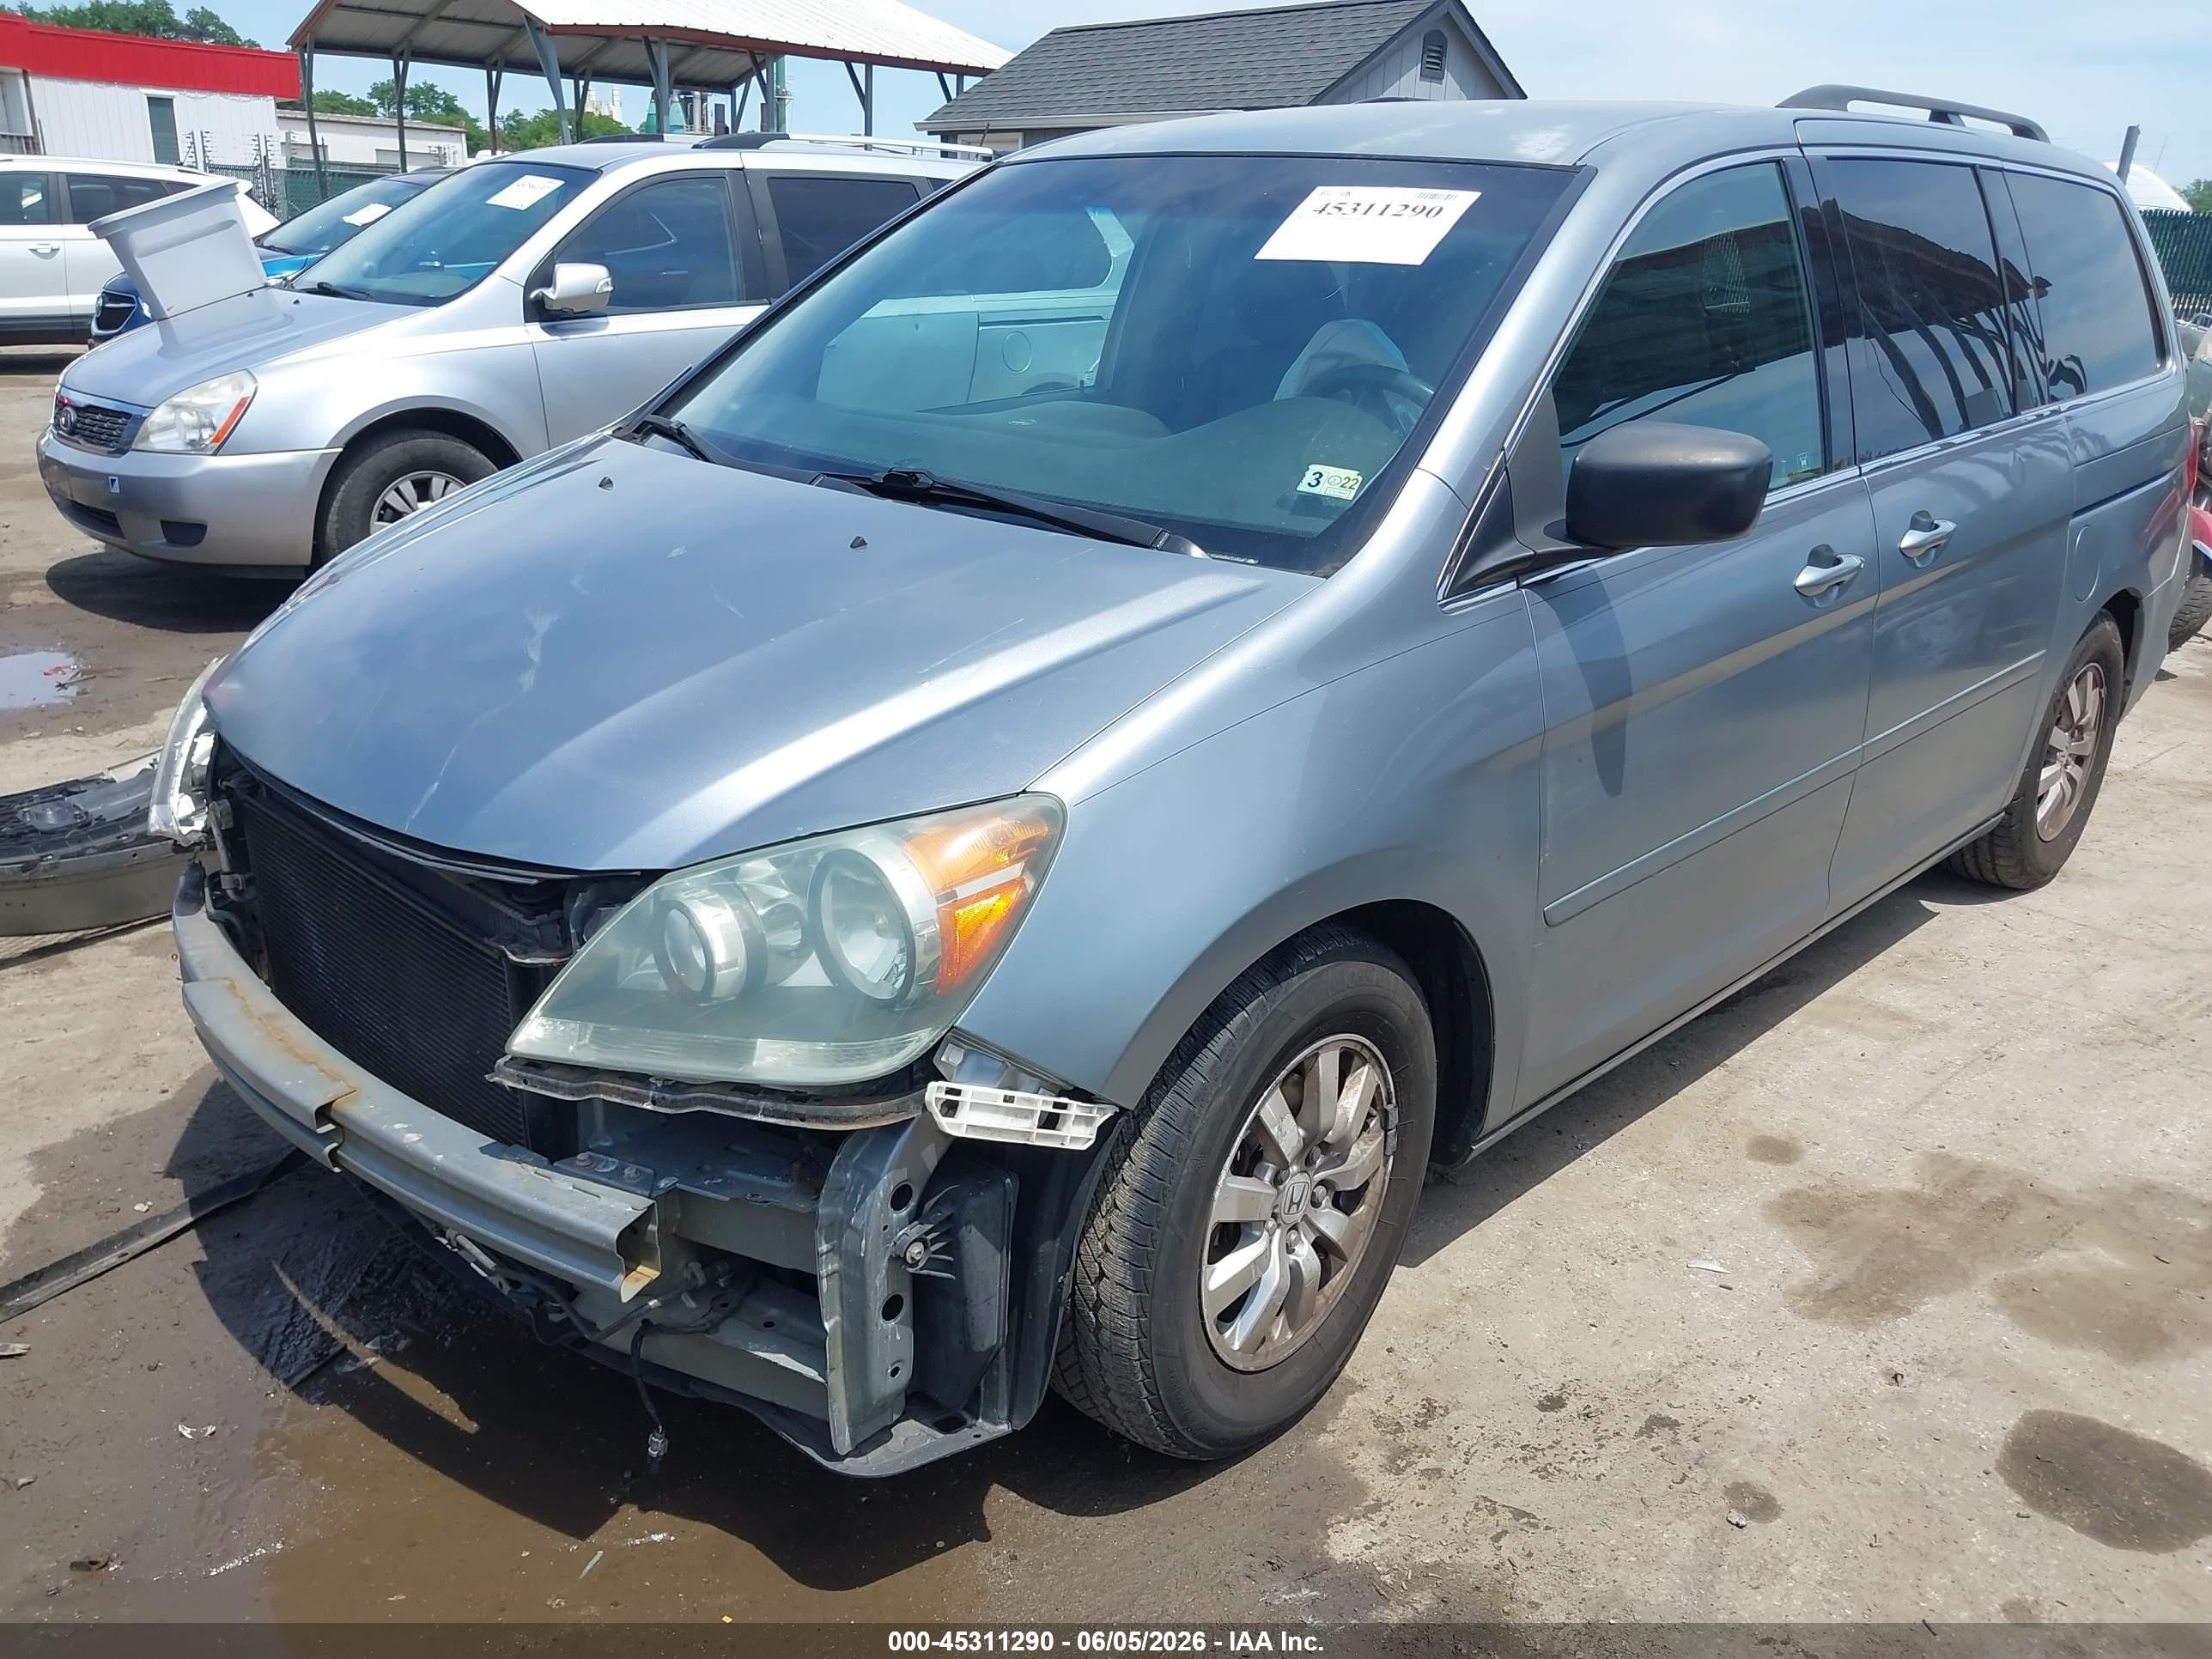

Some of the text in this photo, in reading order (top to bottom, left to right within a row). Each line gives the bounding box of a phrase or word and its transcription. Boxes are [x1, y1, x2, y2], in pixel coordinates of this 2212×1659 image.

[1312, 201, 1444, 219] 45311290
[1307, 471, 1359, 489] 3 22
